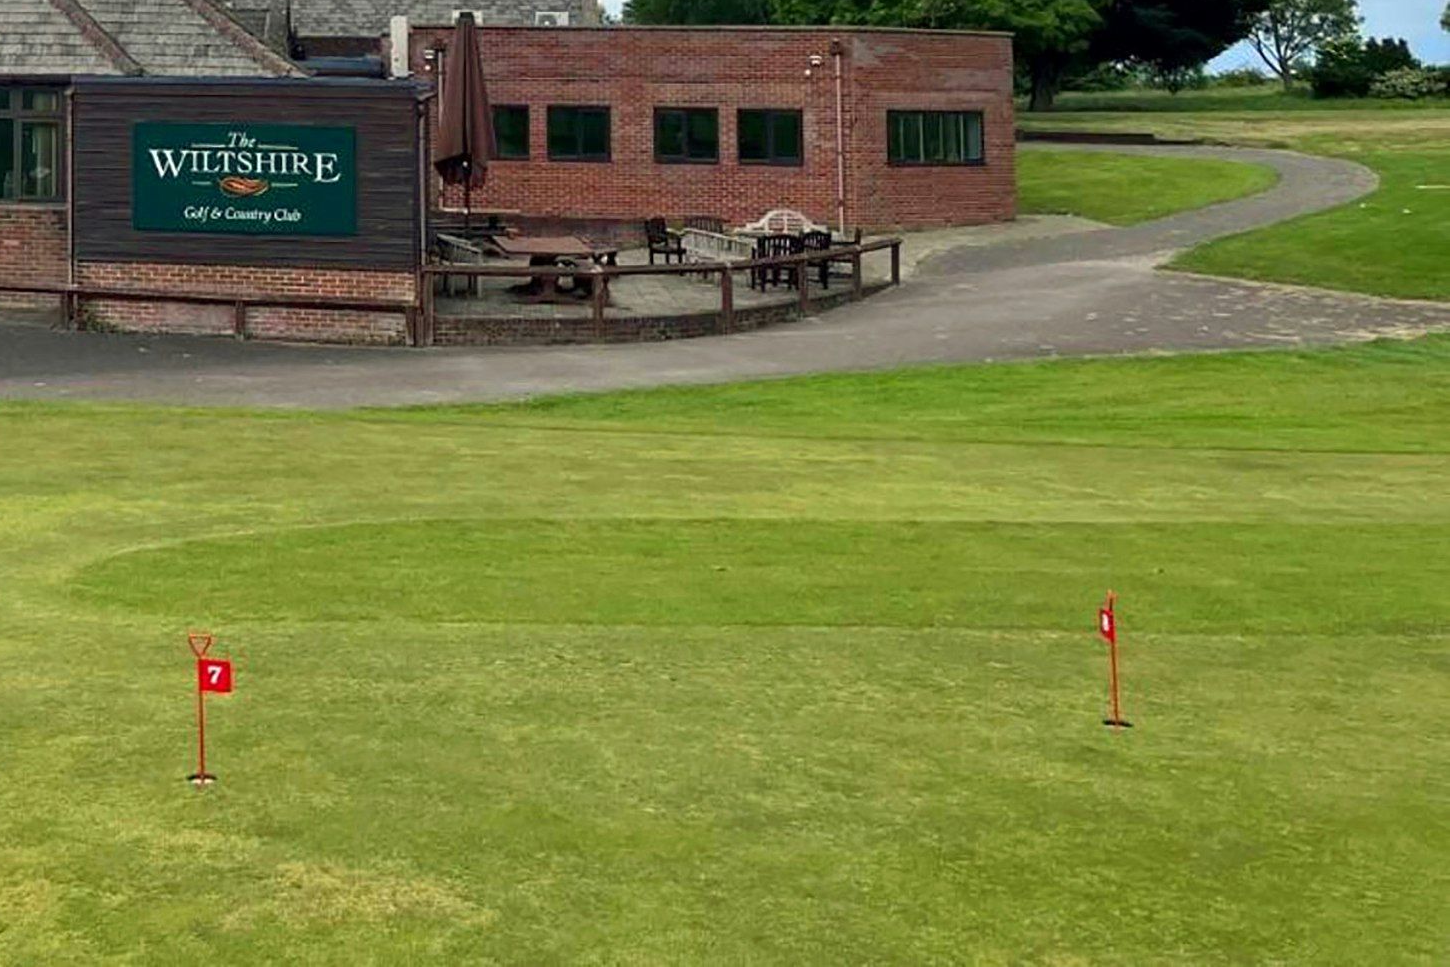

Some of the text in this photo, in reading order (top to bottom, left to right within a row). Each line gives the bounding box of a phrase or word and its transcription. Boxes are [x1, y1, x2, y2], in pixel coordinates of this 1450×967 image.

[227, 132, 257, 148] The
[149, 149, 342, 183] WILTSHIRE
[184, 206, 302, 224] Golf & Country Club
[207, 665, 223, 684] 7
